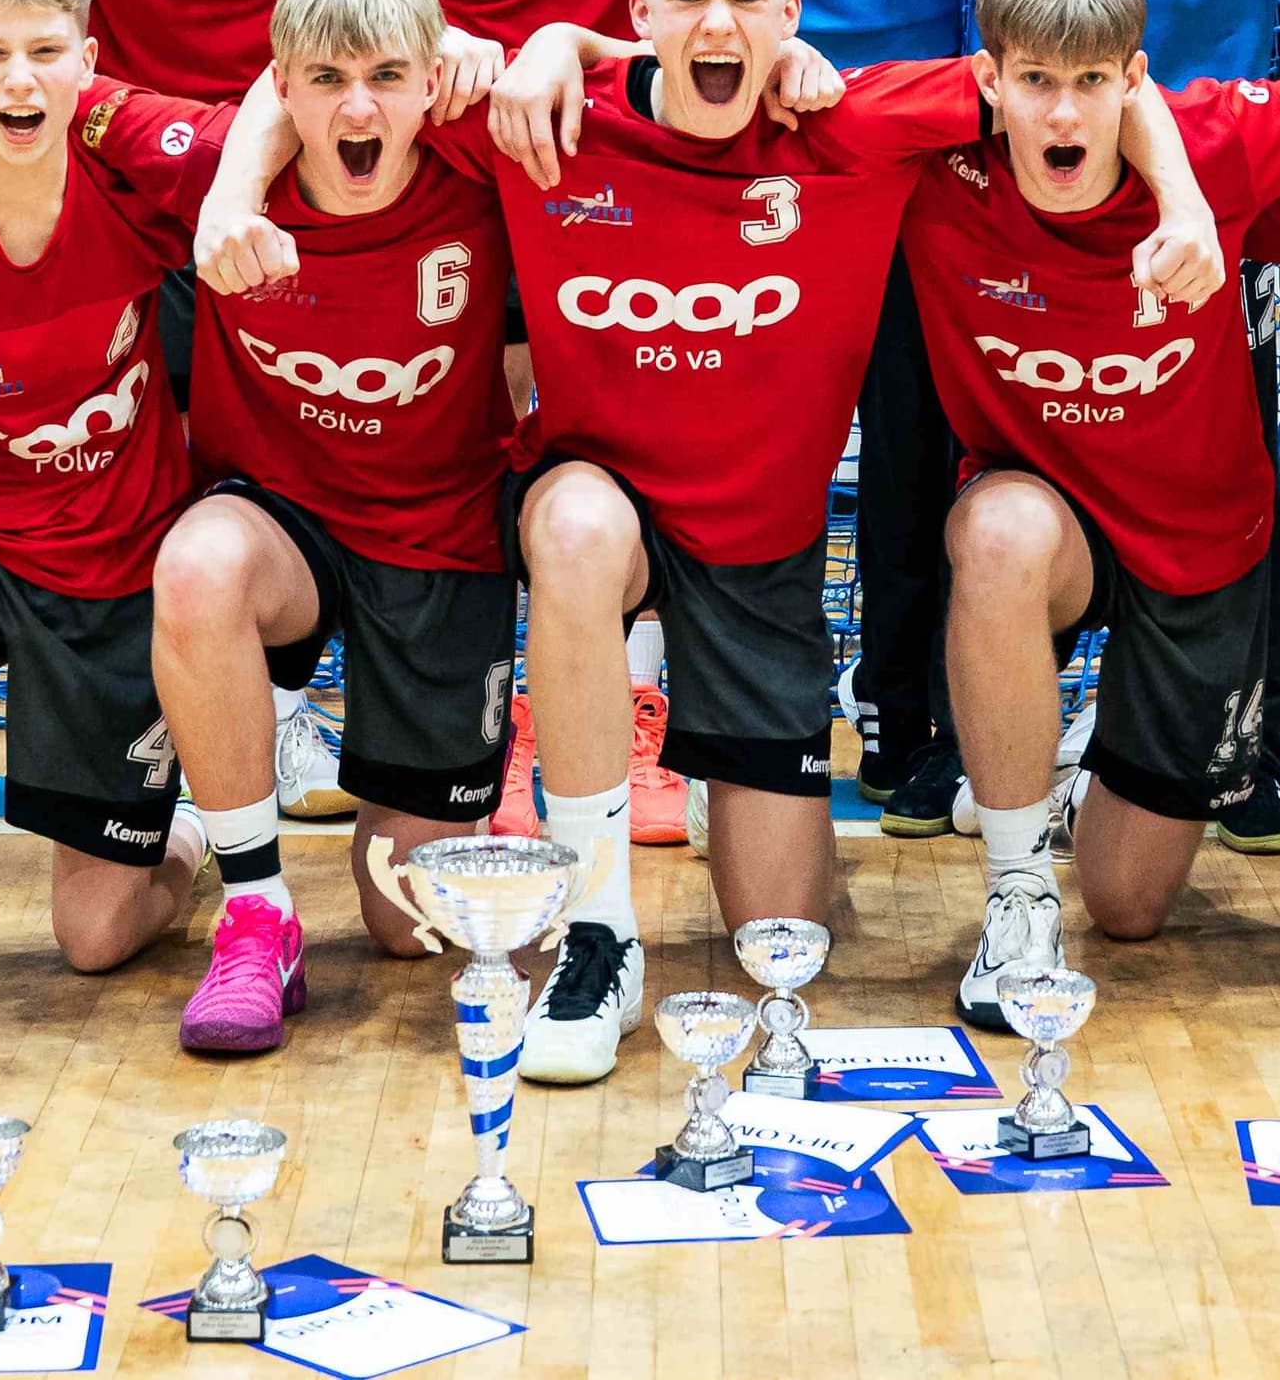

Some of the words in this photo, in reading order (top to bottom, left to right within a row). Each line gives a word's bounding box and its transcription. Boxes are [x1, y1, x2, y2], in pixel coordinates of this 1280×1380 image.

[947, 153, 990, 190] Kemp
[740, 175, 801, 247] 3
[416, 241, 472, 327] 6
[557, 274, 801, 336] coop
[237, 328, 456, 406] coop
[635, 344, 722, 372] Põva
[974, 335, 1195, 396] coop
[299, 401, 383, 436] Põlva
[1042, 401, 1125, 424] Põlva
[126, 714, 177, 789] 4
[801, 754, 831, 778] Kemp
[103, 819, 162, 850] Kempa
[728, 1123, 856, 1153] DIPLOM
